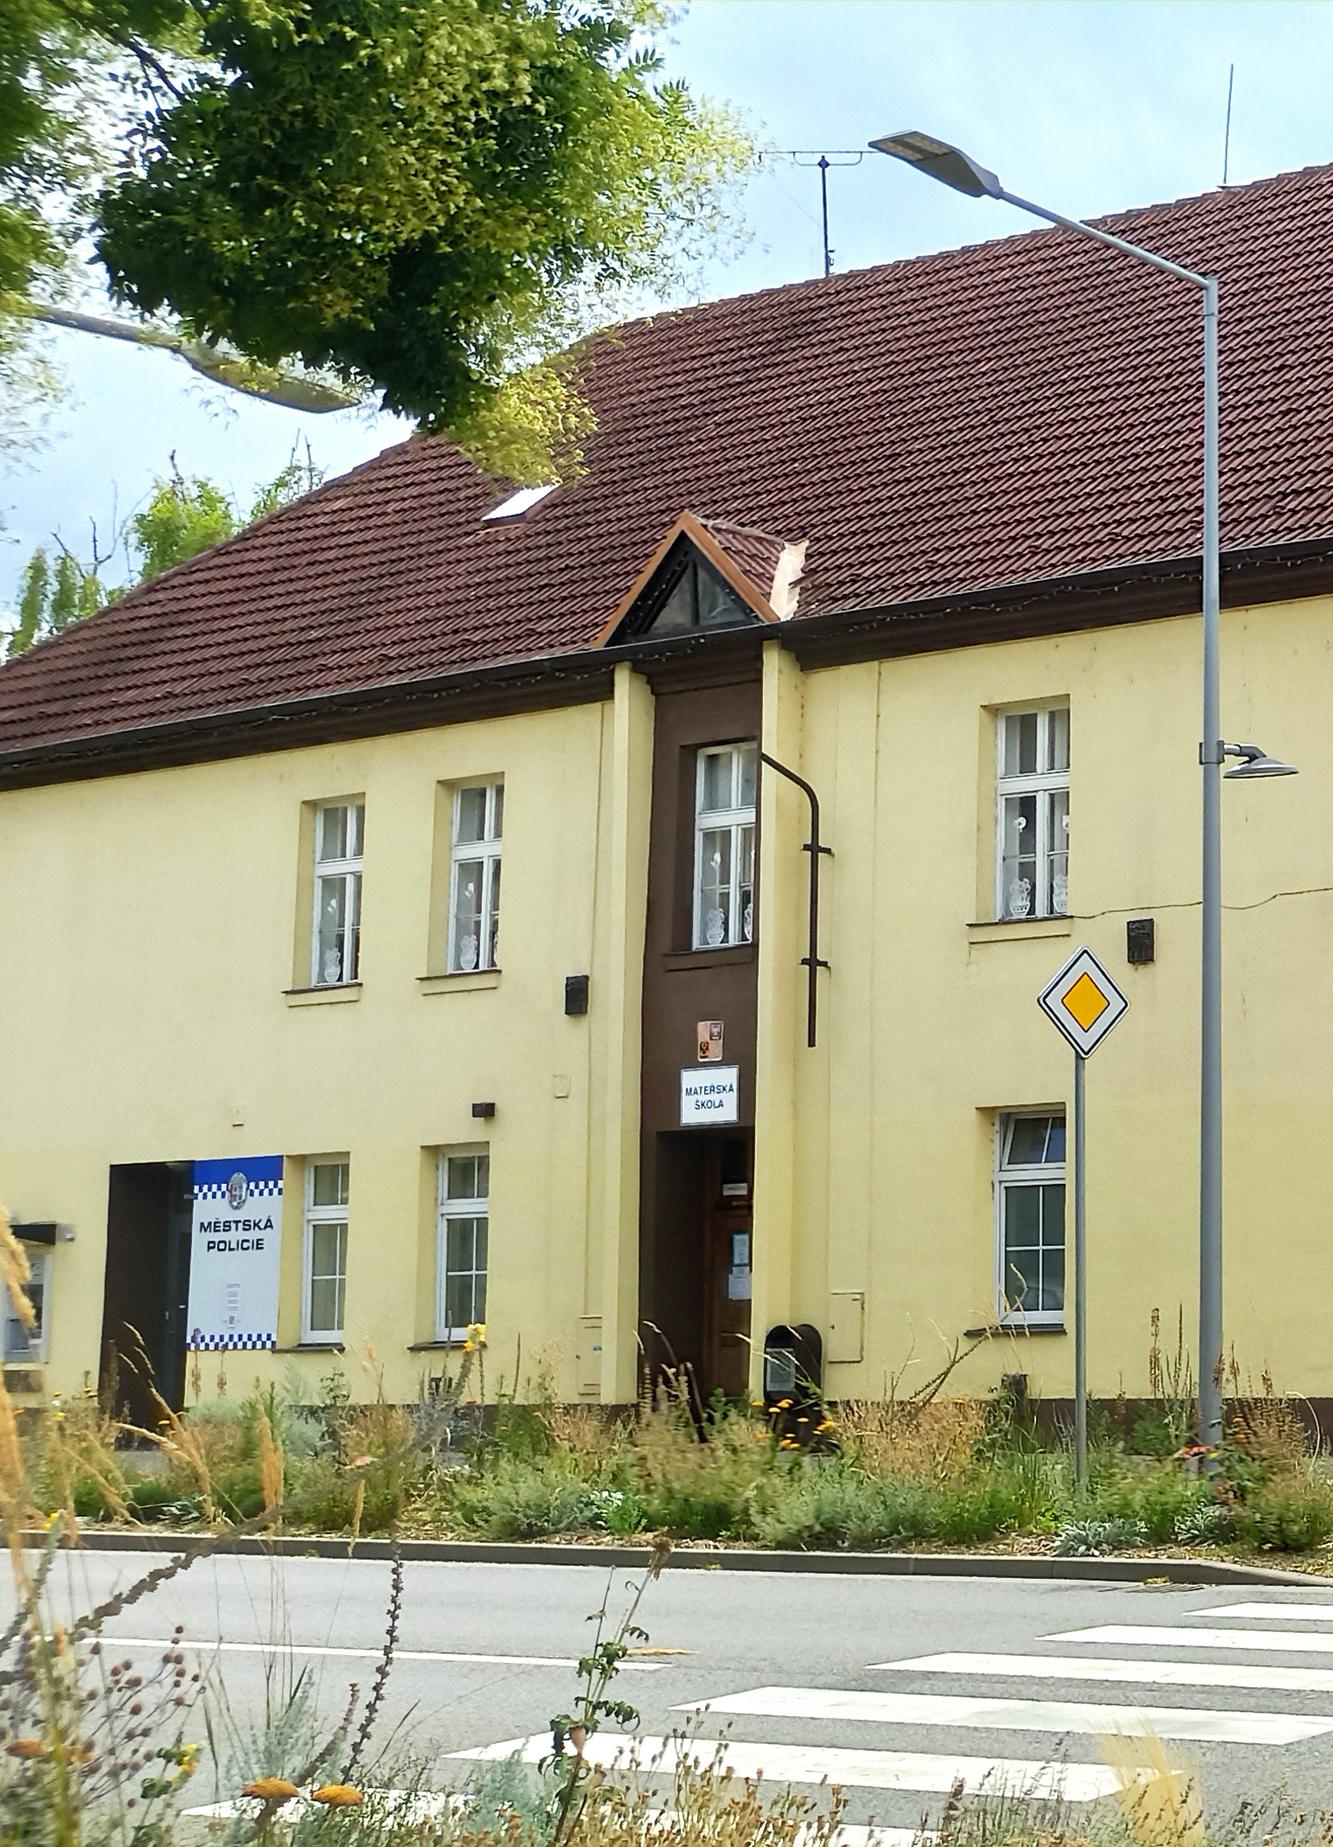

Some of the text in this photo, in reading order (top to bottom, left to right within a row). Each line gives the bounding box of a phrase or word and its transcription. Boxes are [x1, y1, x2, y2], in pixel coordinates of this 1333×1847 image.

[685, 1082, 735, 1097] MATEŘSKÁ
[694, 1099, 725, 1111] ŠKOLA
[199, 1215, 275, 1234] MĚSTSKÁ
[206, 1238, 265, 1253] POLICIE
